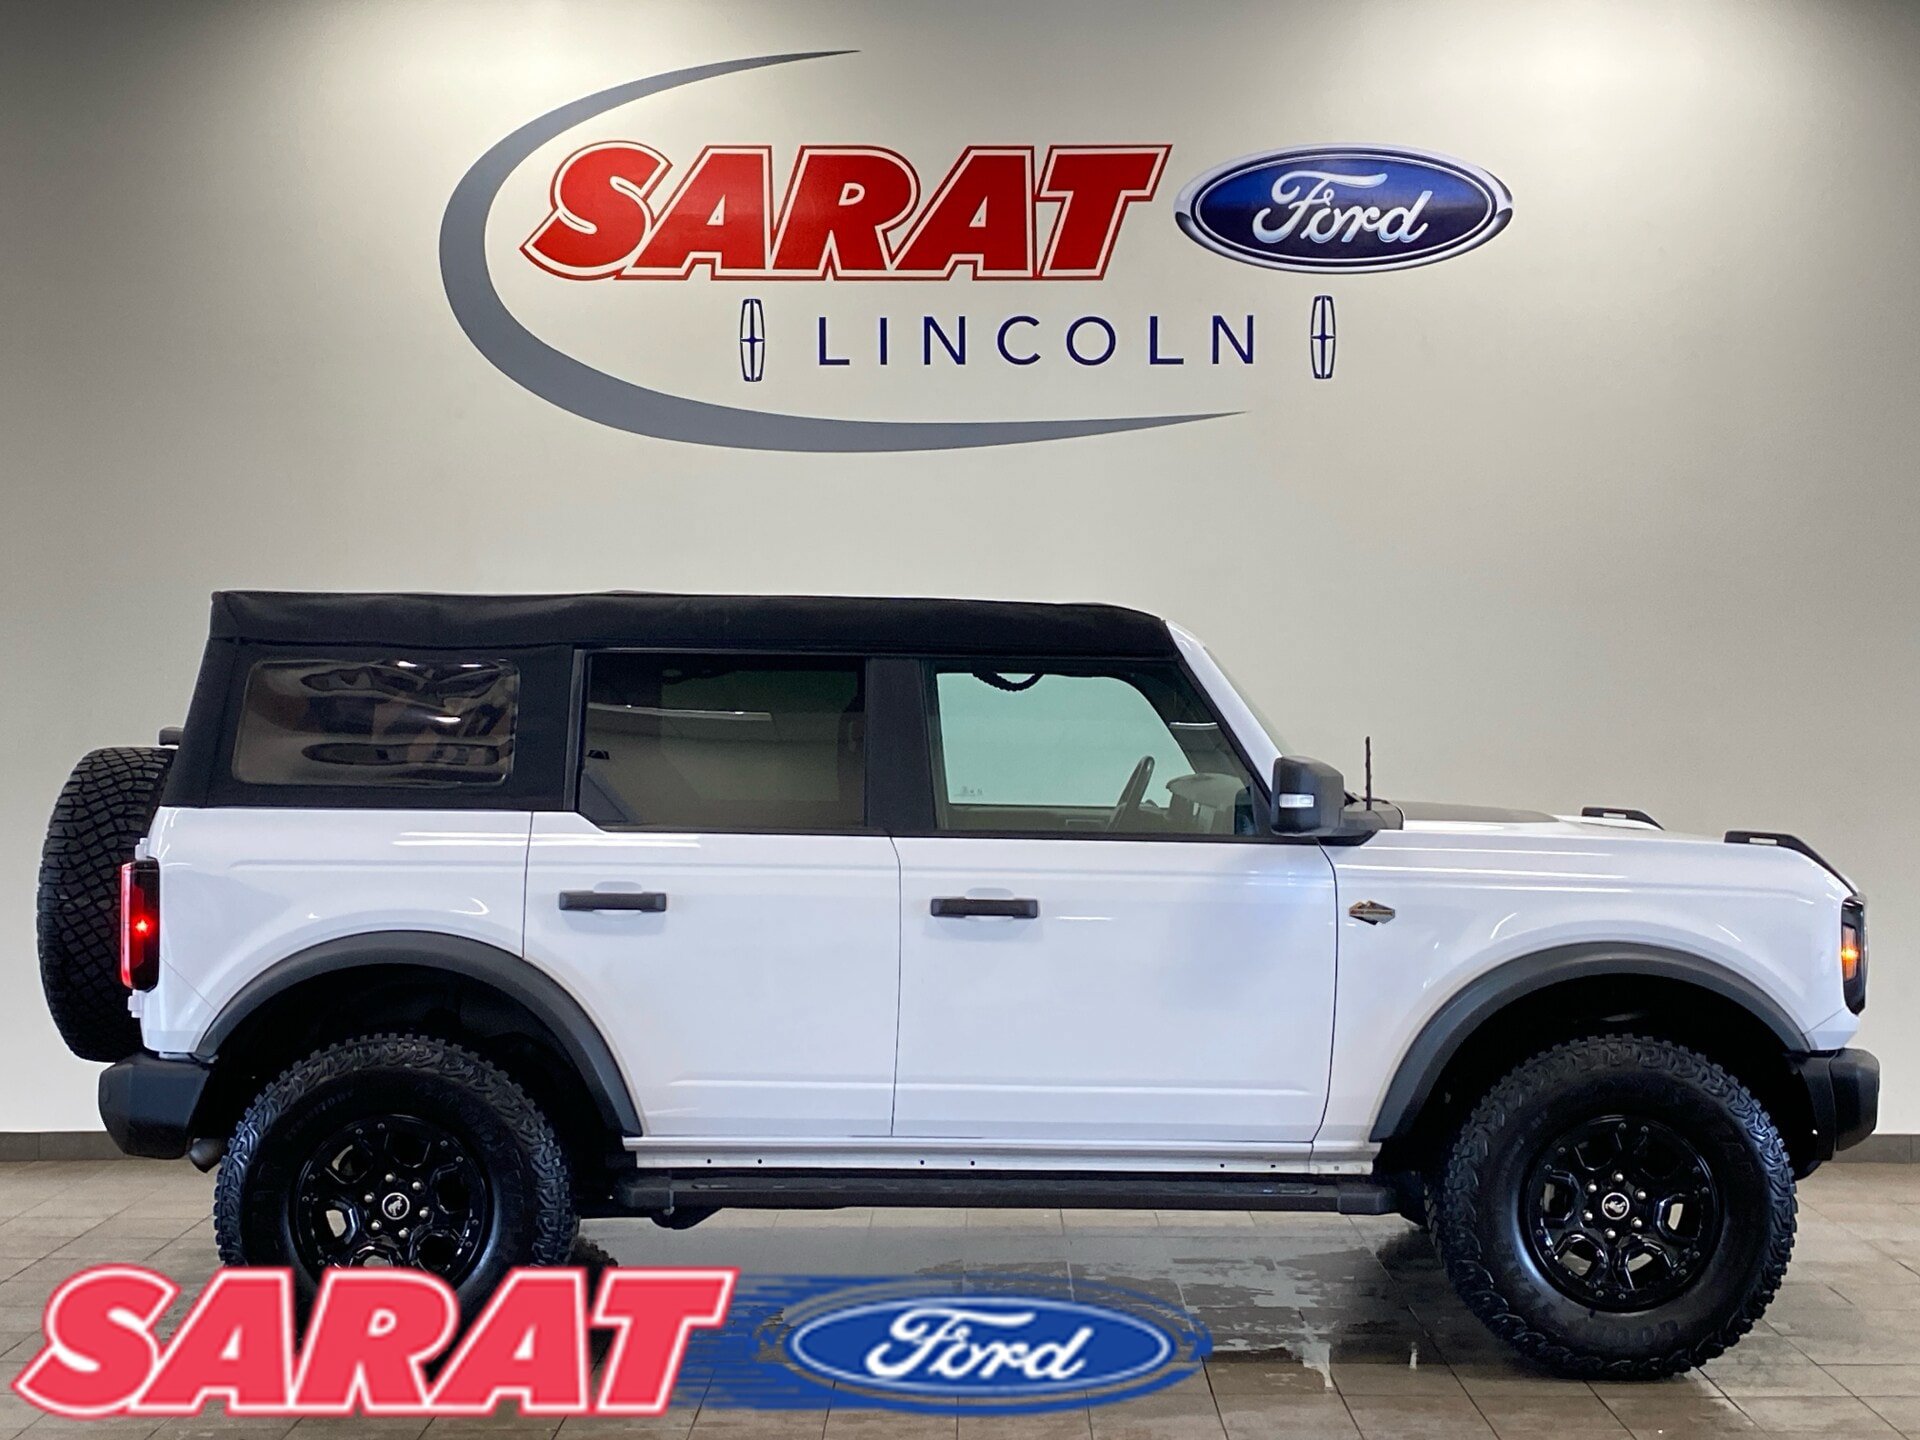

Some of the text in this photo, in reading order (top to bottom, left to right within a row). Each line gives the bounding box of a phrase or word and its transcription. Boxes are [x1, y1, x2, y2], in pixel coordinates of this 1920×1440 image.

[521, 140, 1432, 281] SARAT Ford
[819, 313, 1254, 366] LINCOLN
